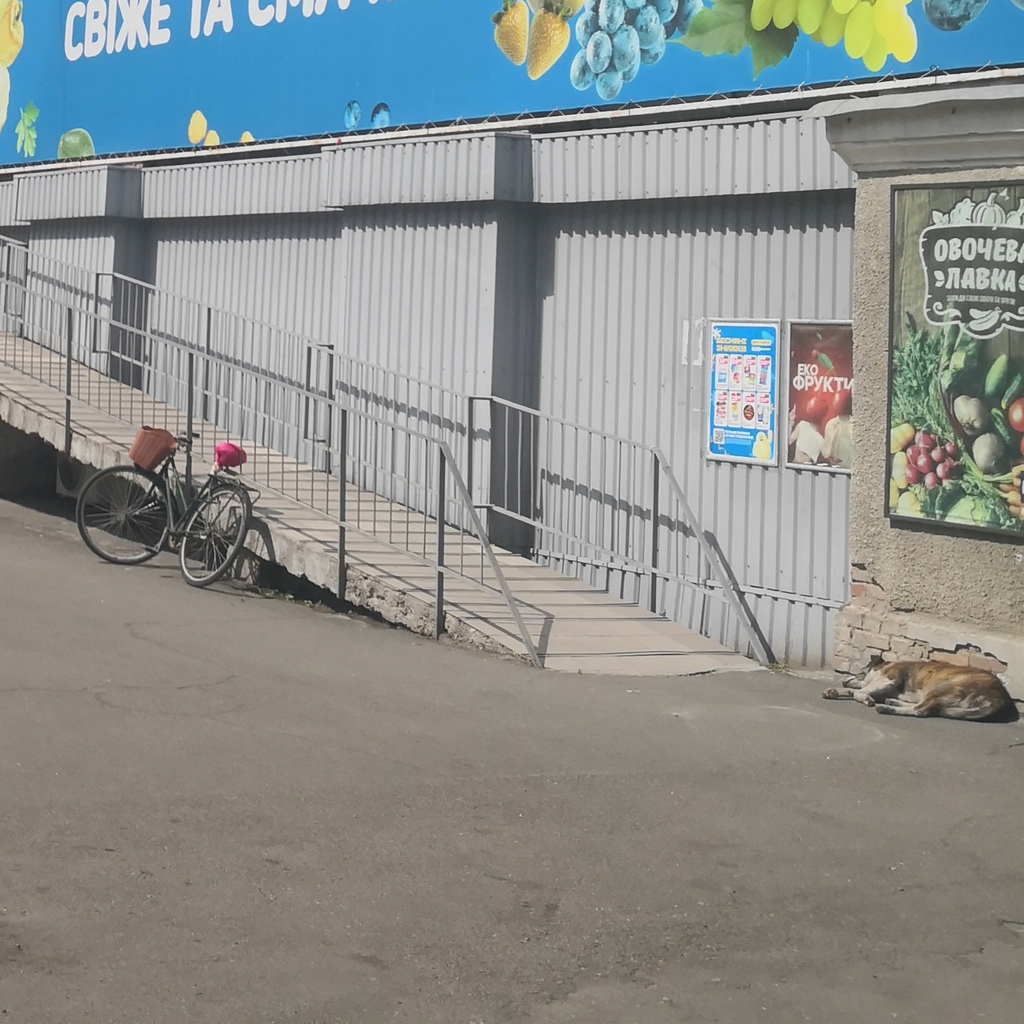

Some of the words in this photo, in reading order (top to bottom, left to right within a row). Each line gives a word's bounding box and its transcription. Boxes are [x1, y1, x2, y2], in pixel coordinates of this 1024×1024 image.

[945, 267, 1016, 293] ЛАВКА
[797, 363, 819, 376] ЕКО
[792, 375, 855, 393] ФРУКТИ
